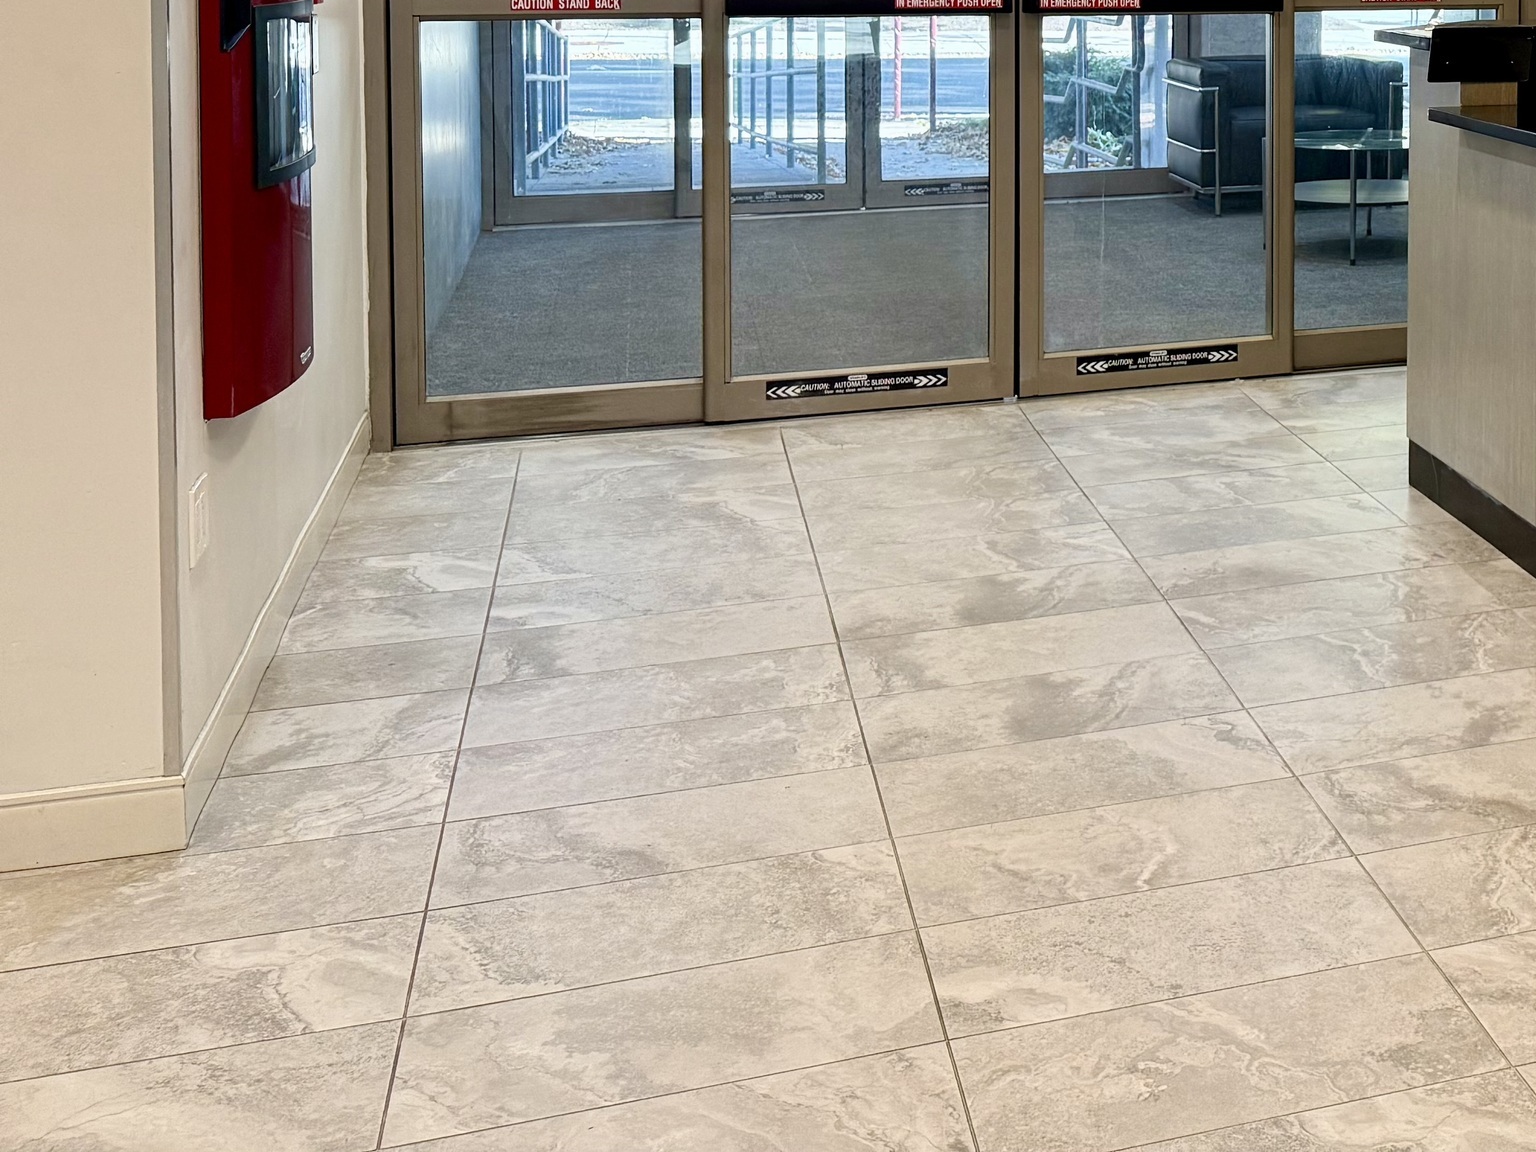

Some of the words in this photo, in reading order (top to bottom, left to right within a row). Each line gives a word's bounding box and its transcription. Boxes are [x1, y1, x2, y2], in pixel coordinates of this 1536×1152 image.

[1137, 355, 1169, 364] AUTOMATIC
[1170, 353, 1191, 361] SLIDING
[800, 383, 830, 392] CAUTION:
[833, 380, 870, 388] AUTOMATIC
[871, 378, 895, 386] SLIDING
[895, 376, 914, 384] DOOR
